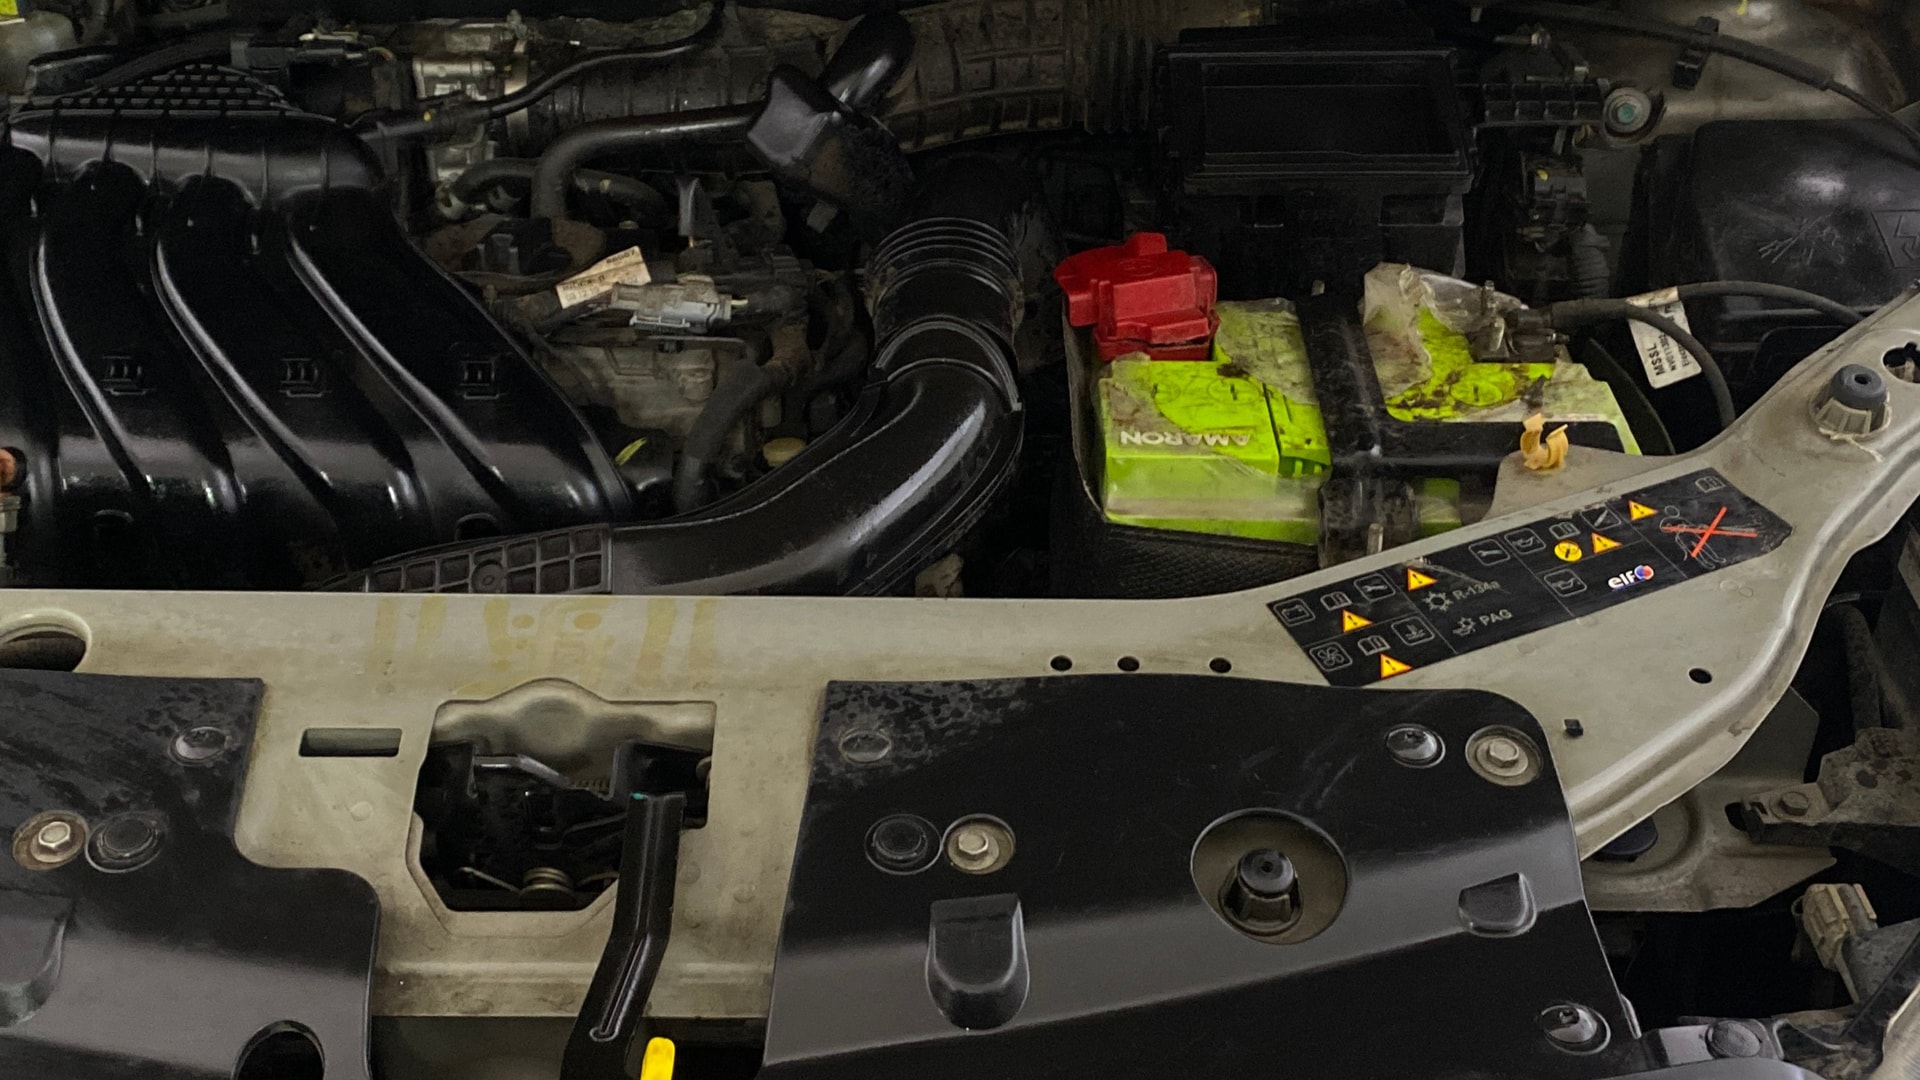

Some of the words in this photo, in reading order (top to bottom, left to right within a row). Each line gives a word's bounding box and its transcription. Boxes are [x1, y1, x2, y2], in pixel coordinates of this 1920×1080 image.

[1647, 343, 1666, 376] MSSL
[1120, 431, 1250, 446] AMARON
[1607, 570, 1636, 589] elf
[1452, 581, 1500, 600] R-134a
[1479, 609, 1513, 626] PAG
